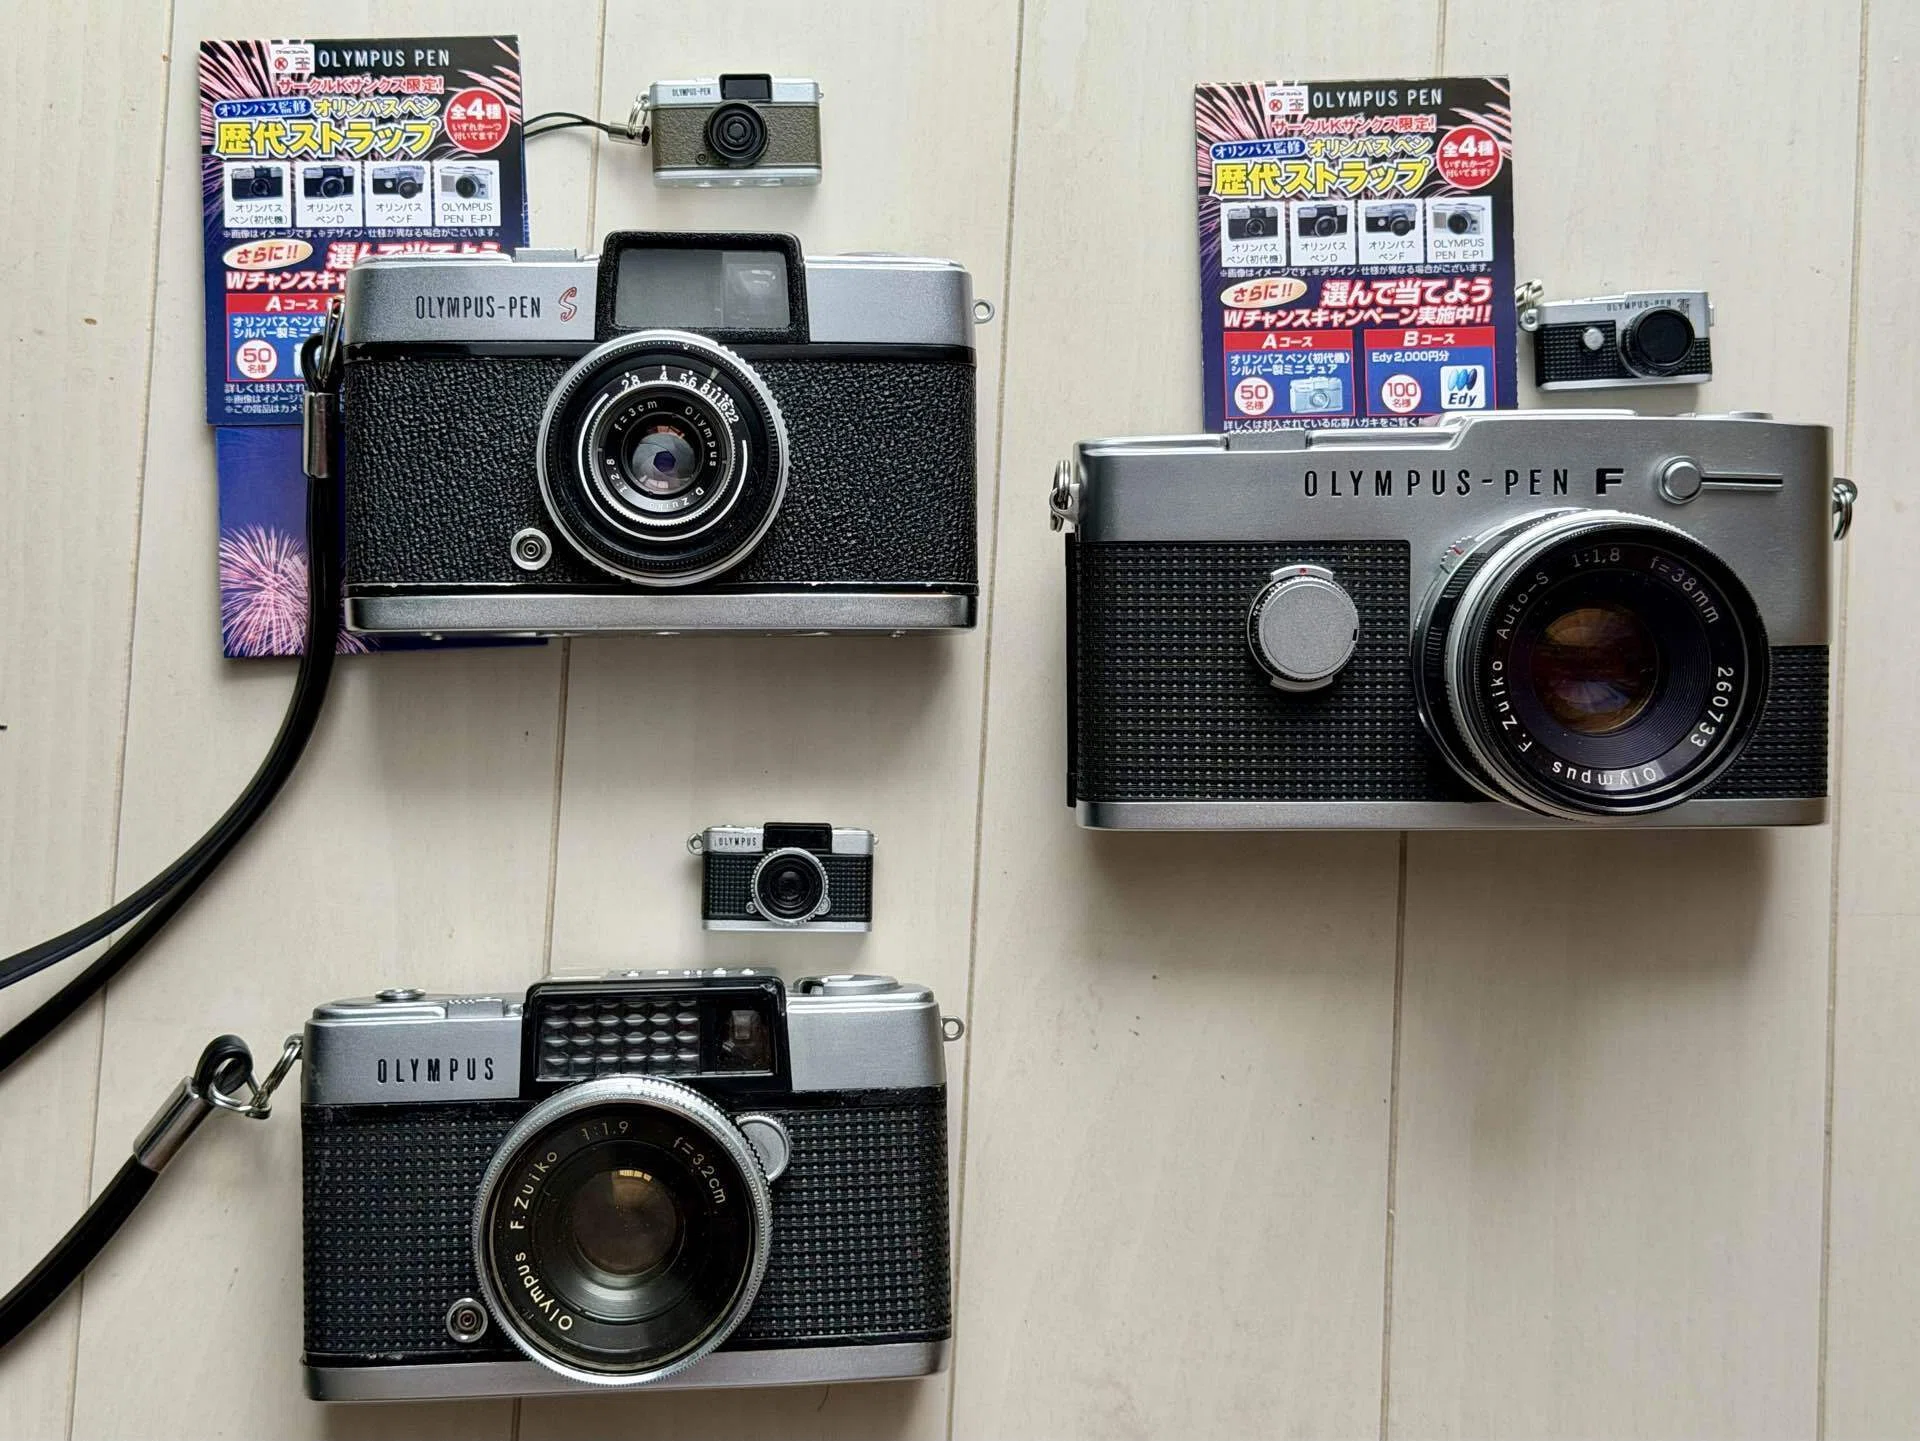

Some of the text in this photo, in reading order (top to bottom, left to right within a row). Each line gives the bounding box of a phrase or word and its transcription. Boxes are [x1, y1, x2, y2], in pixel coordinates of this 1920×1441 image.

[319, 49, 406, 67] OLYMPUS
[415, 49, 449, 66] PEN
[672, 87, 711, 97] OLYMPUS-PEN
[1313, 90, 1399, 108] OLYMPUS
[1407, 88, 1443, 106] PEN
[217, 120, 438, 157] 歴代ストラップ
[1214, 159, 1430, 196] 歴代ストラップ
[235, 203, 283, 213] オリンパス
[306, 203, 353, 213] オリンパス
[375, 203, 423, 212] オリンパス
[441, 202, 493, 212] OLYMPUS
[315, 215, 344, 224] ペンD
[386, 215, 412, 224] ペンF
[443, 214, 492, 224] PEN E-P1
[1232, 242, 1278, 251] オリンパス
[1301, 242, 1347, 251] オリンパス
[1369, 240, 1415, 250] オリンパス
[1434, 239, 1485, 248] OLYMPUS
[1310, 254, 1338, 263] ペンD
[1379, 253, 1405, 262] ペンF
[1435, 250, 1484, 260] PEN E-P1
[1321, 278, 1492, 307] 選んで当てよう
[416, 287, 577, 322] OLYMPUS-PEN S
[243, 348, 272, 363] 50
[247, 364, 267, 373] 名様
[1231, 364, 1338, 376] シルバー製ミニチュア
[660, 371, 669, 381] 4
[700, 383, 710, 394] 8
[1240, 384, 1268, 399] 50
[1387, 382, 1418, 397] 100
[1245, 398, 1265, 409] 名様
[1392, 397, 1411, 408] 名様
[1448, 393, 1477, 408] Edy
[684, 406, 717, 467] Olympus
[1304, 467, 1624, 498] OLYMPUS-PEN F
[1649, 556, 1720, 624] f=38mm
[1496, 571, 1550, 640] Auto-S
[1690, 666, 1734, 748] 260733
[1552, 761, 1657, 786] Olympus
[718, 837, 757, 847] OLYMPUS
[377, 1057, 495, 1084] OLYMPUS
[581, 1120, 629, 1141] 1:1.9
[510, 1151, 558, 1230] F.Zuiko
[515, 1251, 573, 1331] Olympus
